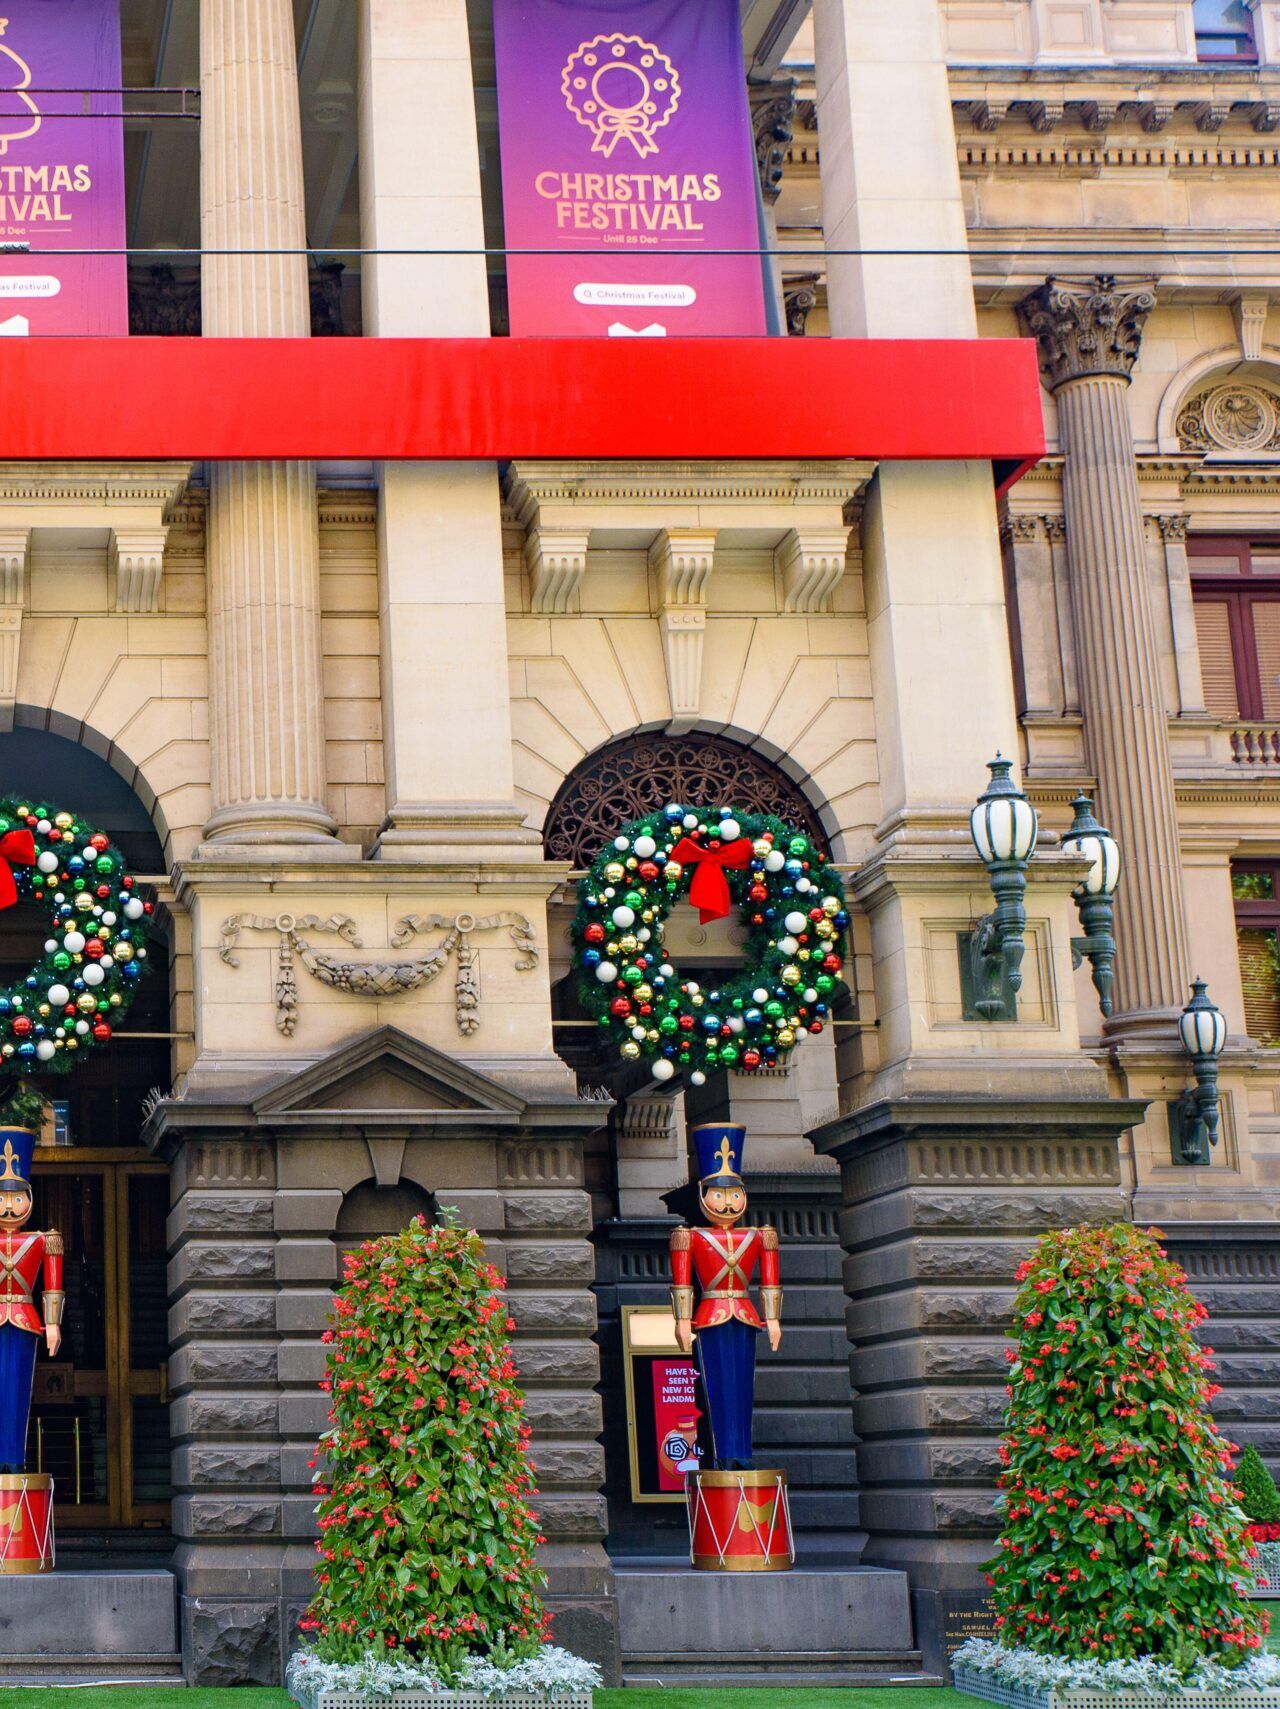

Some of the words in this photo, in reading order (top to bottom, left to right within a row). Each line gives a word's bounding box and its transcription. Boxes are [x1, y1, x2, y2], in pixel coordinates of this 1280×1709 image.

[535, 171, 721, 201] CHRISTMAS
[556, 201, 704, 230] FESTIVAL
[8, 226, 26, 235] Dec
[603, 234, 624, 244] Until
[626, 235, 638, 244] 25
[640, 235, 658, 244] Dec
[13, 282, 50, 291] Festival
[597, 290, 646, 299] Christmas
[648, 291, 685, 300] Festival
[668, 1377, 688, 1385] SEEN
[662, 1386, 682, 1394] NEW
